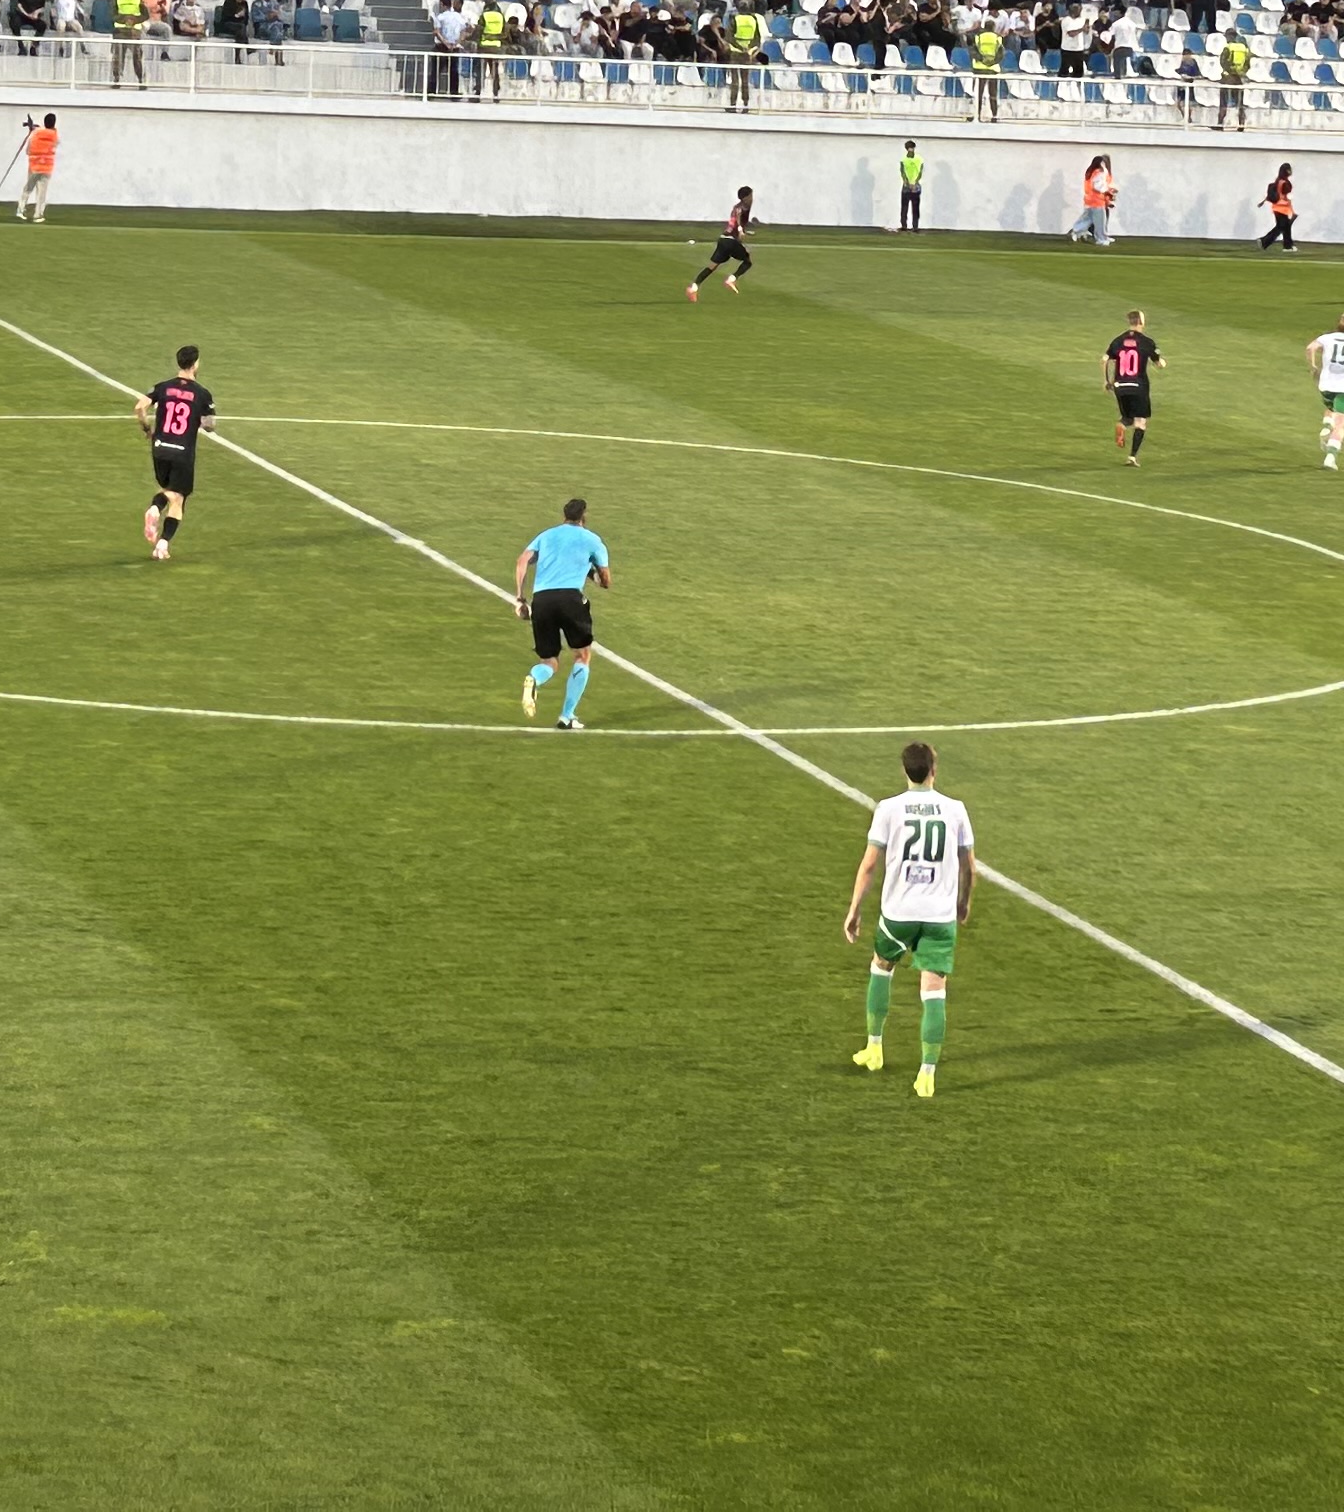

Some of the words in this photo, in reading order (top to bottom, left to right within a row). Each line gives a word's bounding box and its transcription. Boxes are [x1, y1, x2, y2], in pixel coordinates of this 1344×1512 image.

[1119, 349, 1139, 377] 10
[163, 401, 191, 436] 13
[902, 819, 947, 862] 20
